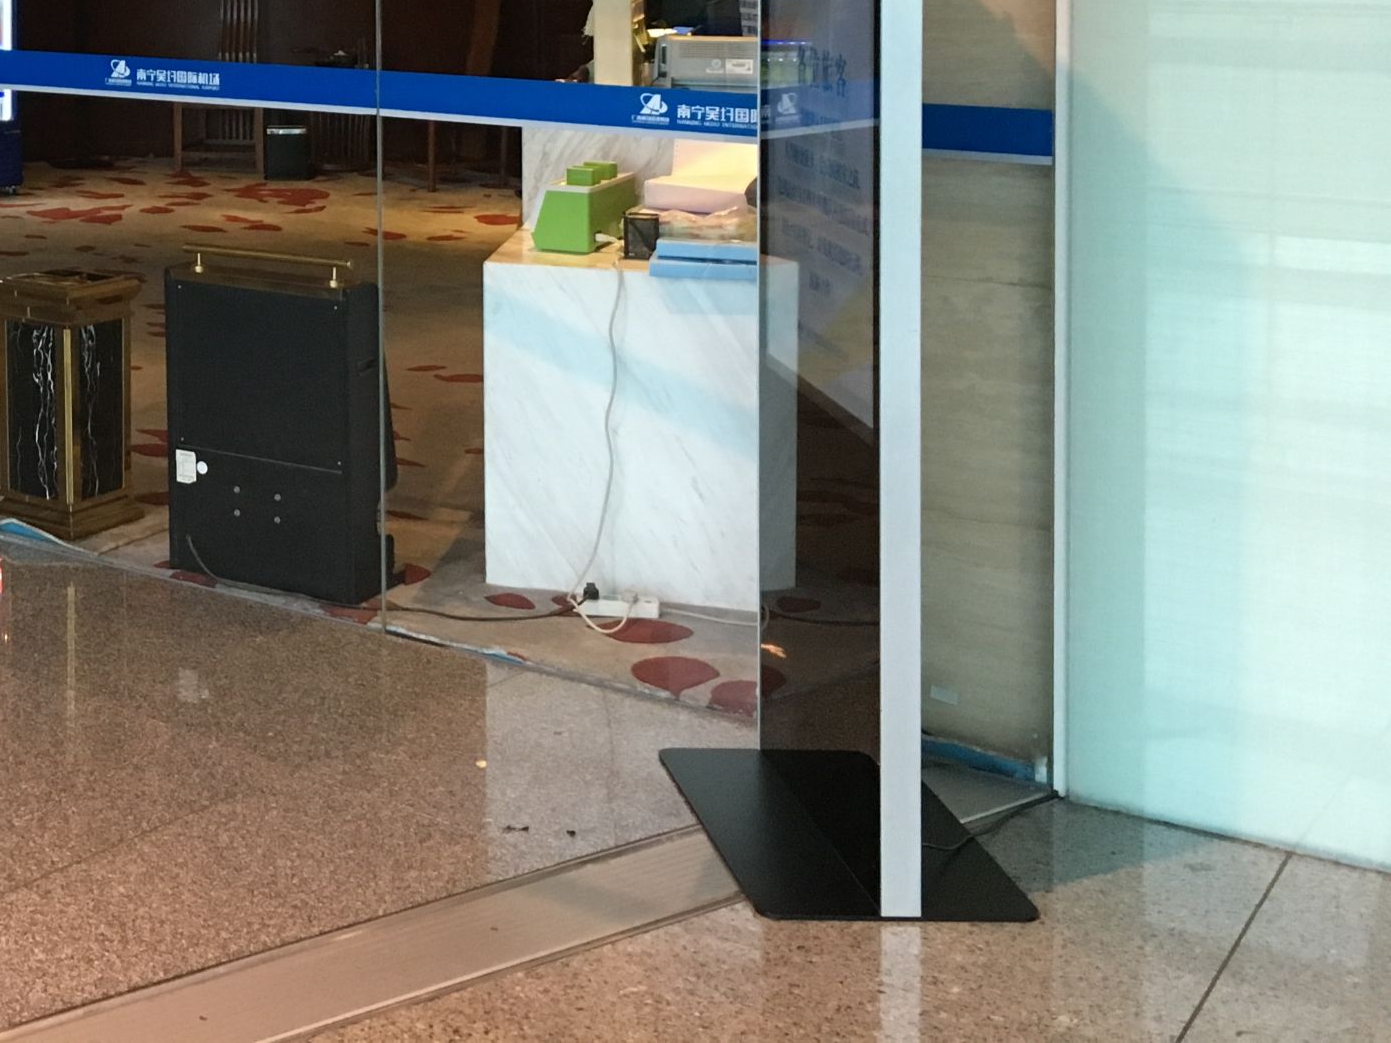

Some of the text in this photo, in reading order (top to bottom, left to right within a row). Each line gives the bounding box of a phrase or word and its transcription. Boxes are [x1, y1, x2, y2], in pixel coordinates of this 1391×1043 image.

[136, 68, 220, 86] 南宁吴圩国际机场
